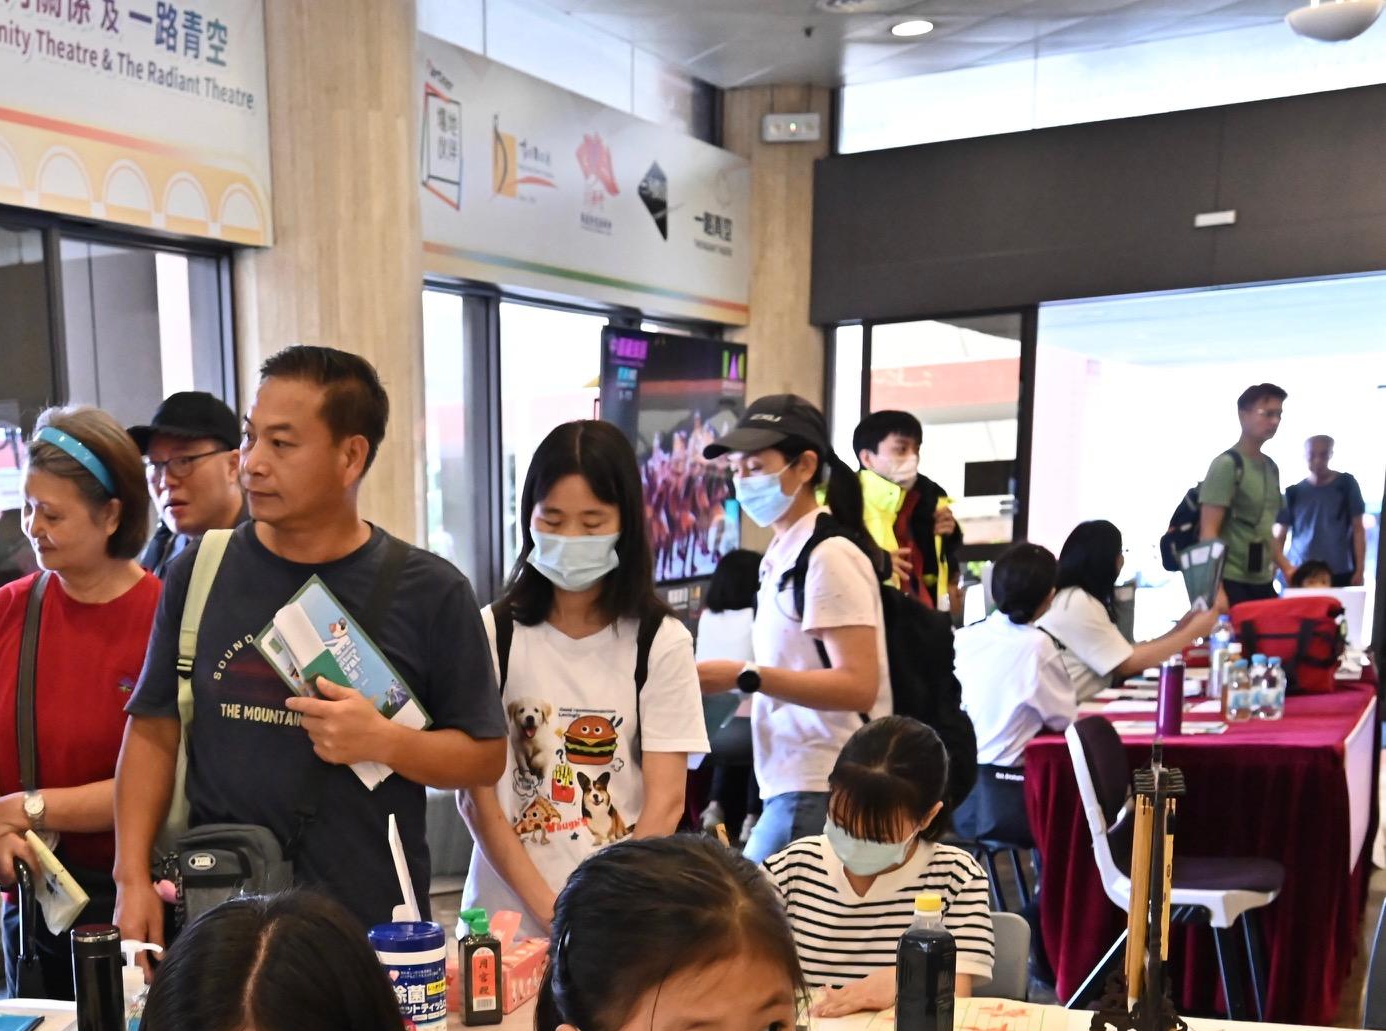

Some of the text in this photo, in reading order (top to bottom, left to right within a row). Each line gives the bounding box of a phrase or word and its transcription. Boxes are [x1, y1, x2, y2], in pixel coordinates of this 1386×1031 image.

[35, 28, 98, 67] Theatre
[102, 48, 112, 71] &
[117, 52, 144, 80] The
[148, 61, 200, 96] Radiant
[204, 77, 255, 110] Theatre
[213, 634, 254, 680] SOUND
[220, 703, 242, 719] THE
